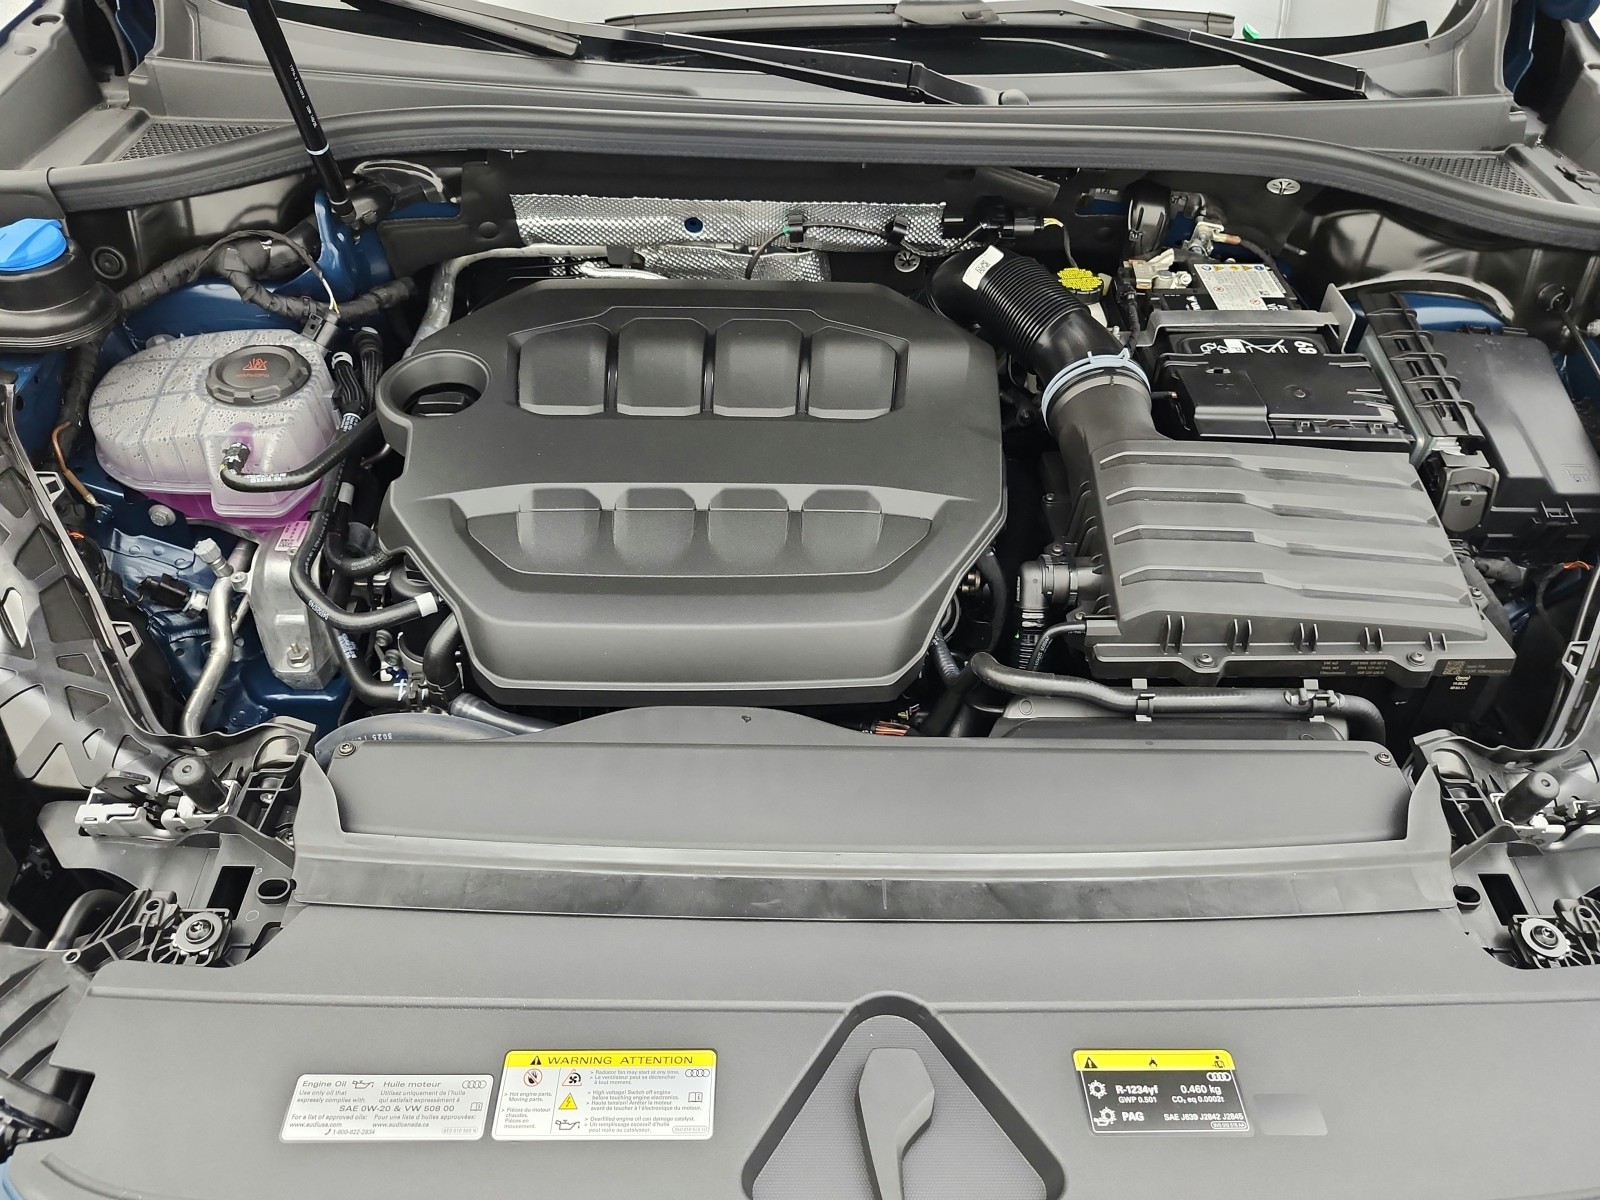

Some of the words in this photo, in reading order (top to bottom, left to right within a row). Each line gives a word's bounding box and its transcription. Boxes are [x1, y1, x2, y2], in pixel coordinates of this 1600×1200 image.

[548, 1056, 612, 1065] WARNING
[620, 1056, 693, 1064] ATTENTION
[1115, 1085, 1158, 1095] R-1234yf
[1180, 1085, 1207, 1094] 0.460
[1209, 1085, 1221, 1095] kg
[1122, 1112, 1144, 1121] PAG
